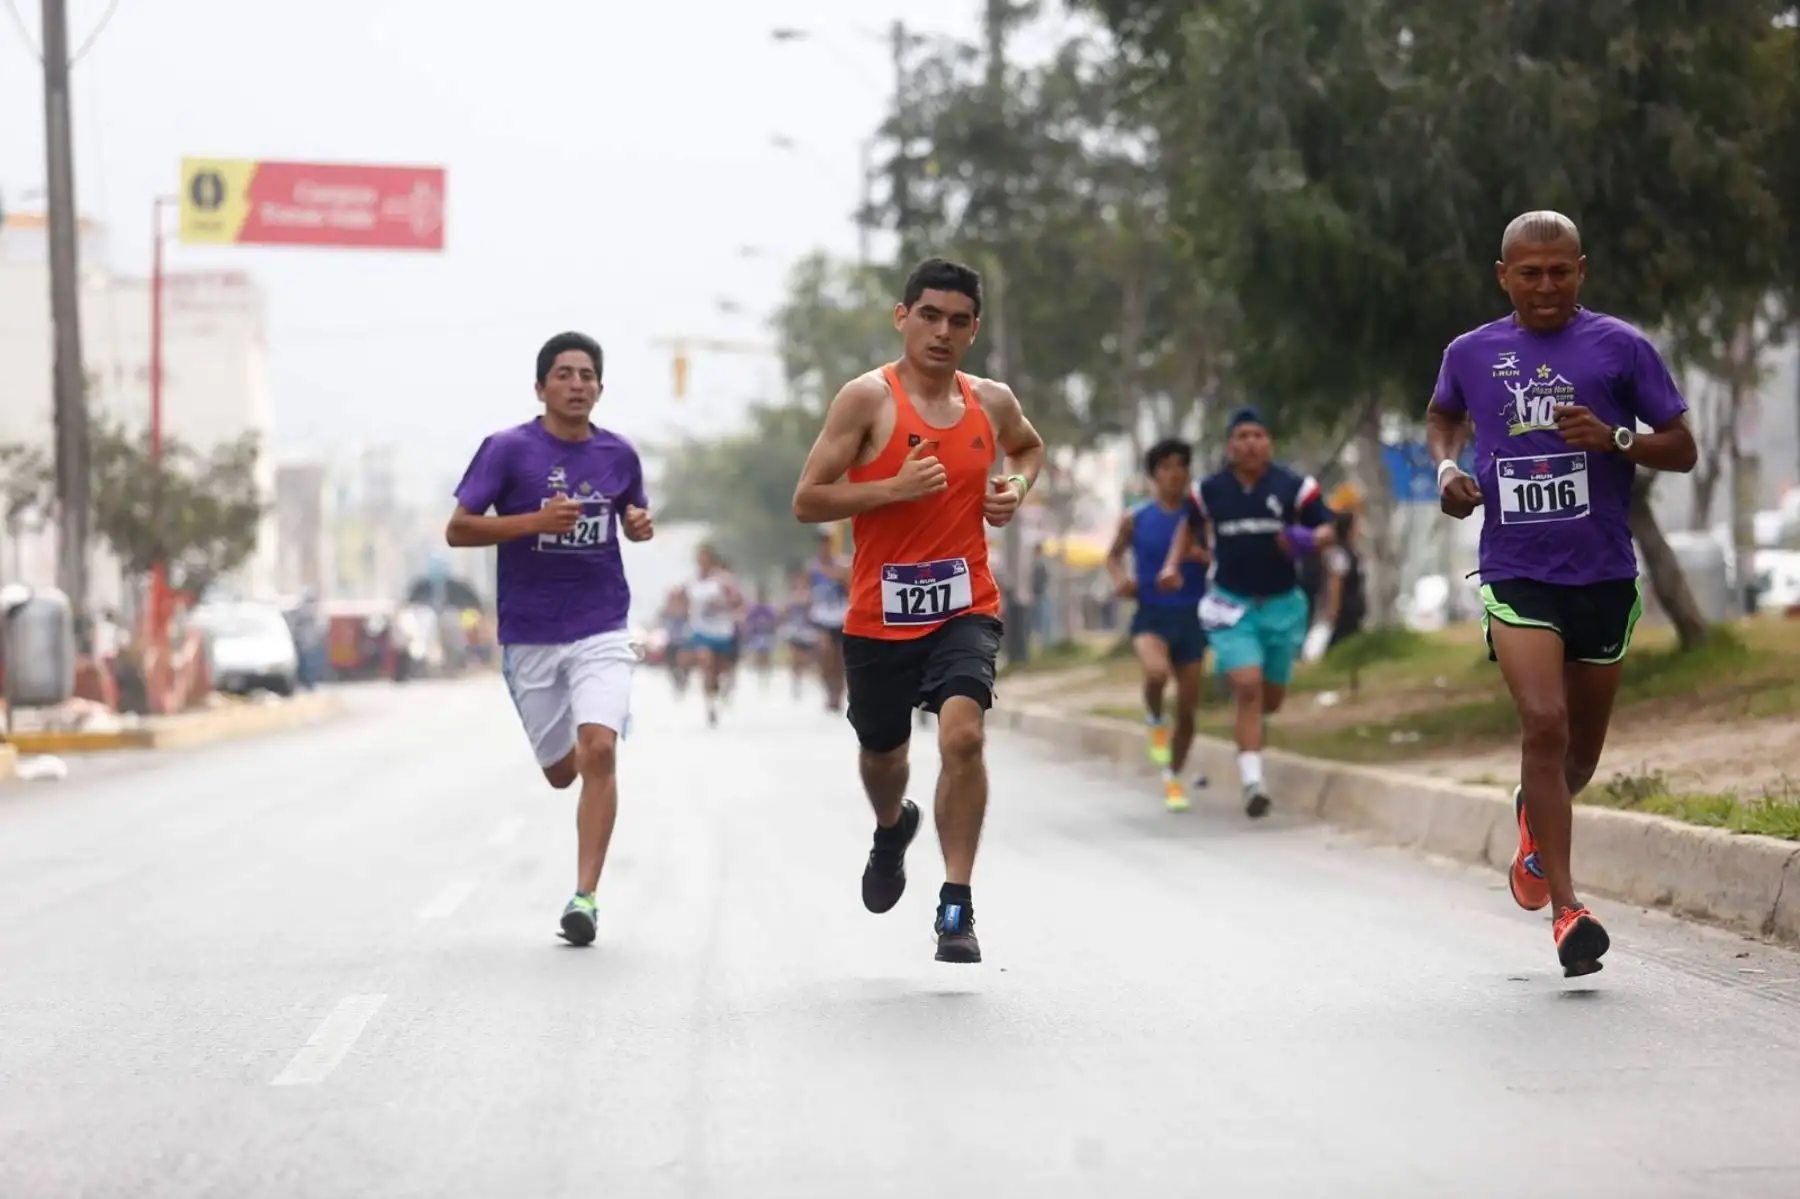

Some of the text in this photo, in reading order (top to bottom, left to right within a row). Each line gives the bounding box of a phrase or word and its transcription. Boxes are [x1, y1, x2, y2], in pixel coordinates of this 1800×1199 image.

[1533, 385, 1575, 395] Plaza Norte
[1527, 395, 1575, 426] 10
[1513, 480, 1576, 513] 1016
[896, 583, 951, 615] 1217
